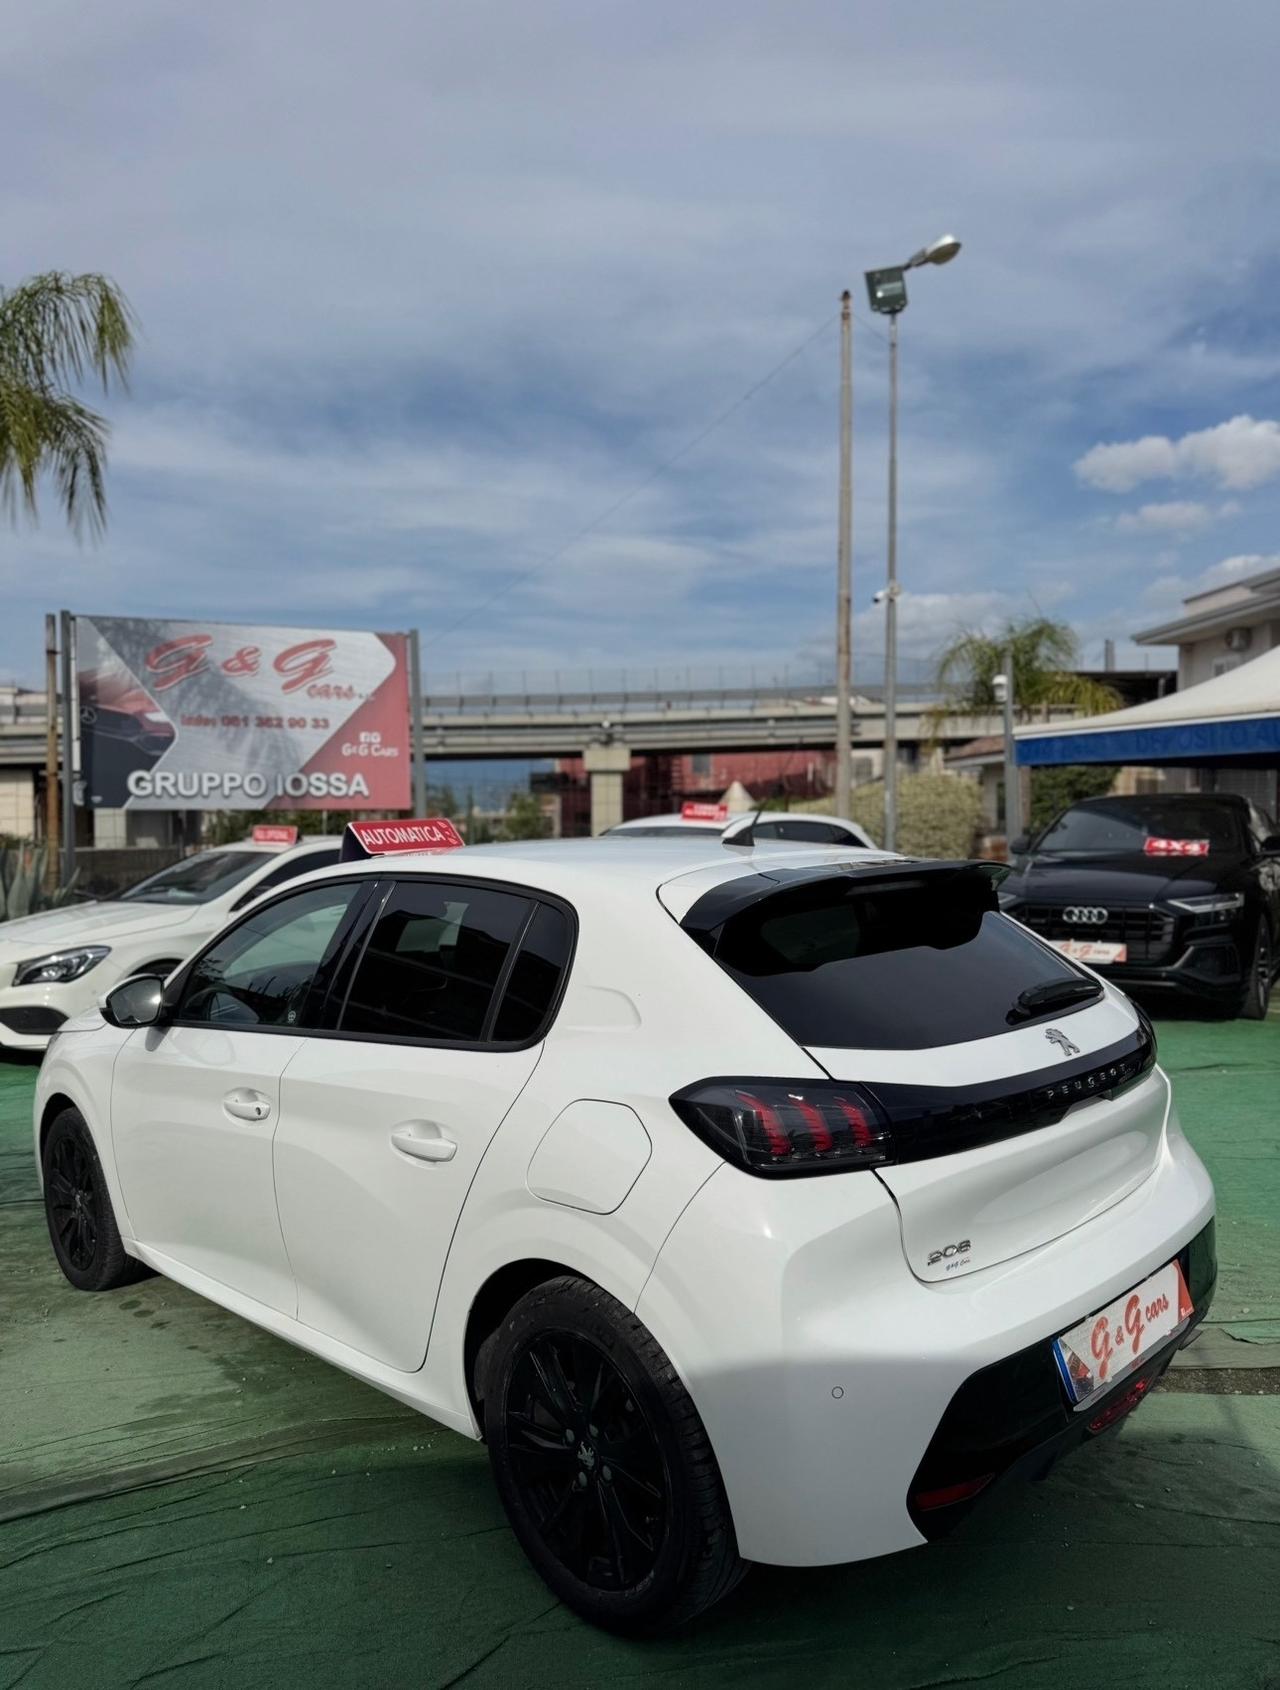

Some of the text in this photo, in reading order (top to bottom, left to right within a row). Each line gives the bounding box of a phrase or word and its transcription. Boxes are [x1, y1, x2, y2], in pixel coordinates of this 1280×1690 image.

[144, 634, 337, 695] G & G
[311, 717, 330, 730] 33
[127, 770, 369, 797] GRUPPO IOSSA
[361, 825, 446, 846] AUTOMATICA
[1046, 1062, 1127, 1099] PEUGEOT
[927, 1239, 971, 1267] 208
[1090, 1293, 1170, 1380] G & G cars
